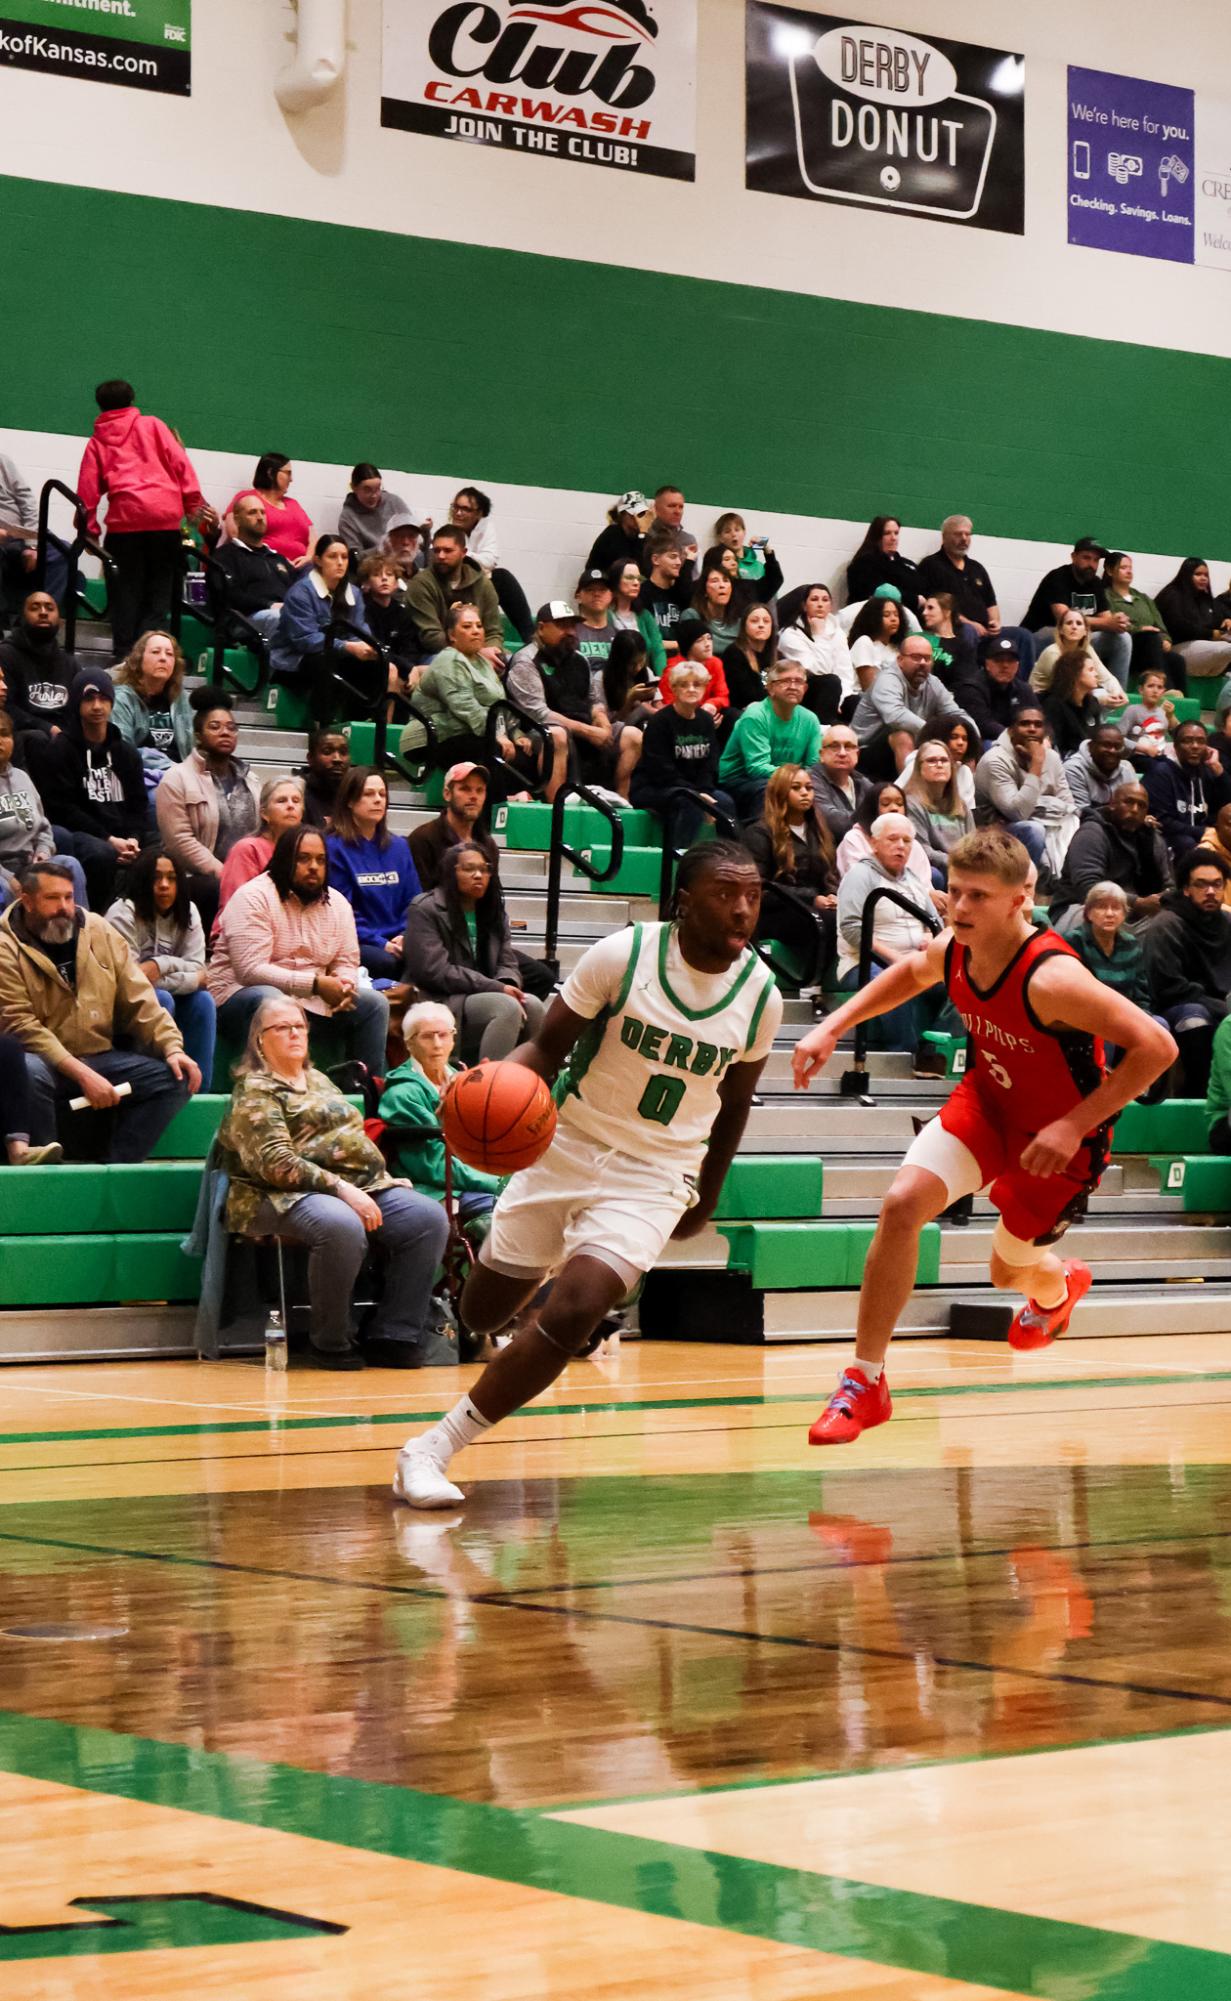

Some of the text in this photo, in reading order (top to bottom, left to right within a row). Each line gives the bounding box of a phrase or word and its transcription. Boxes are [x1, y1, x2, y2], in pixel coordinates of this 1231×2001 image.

[0, 30, 158, 76] kofKansas.com
[428, 2, 656, 109] Club
[840, 36, 932, 97] DERBY
[423, 80, 652, 140] CARWASH
[831, 98, 965, 167] DONUT
[1071, 102, 1190, 141] We're here for you.
[444, 115, 639, 167] JOIN THE CLUB!
[1070, 193, 1192, 226] Checking. Savings. Loans.
[620, 1015, 739, 1077] DERBY
[980, 1048, 1013, 1090] 5
[637, 1073, 687, 1127] 0
